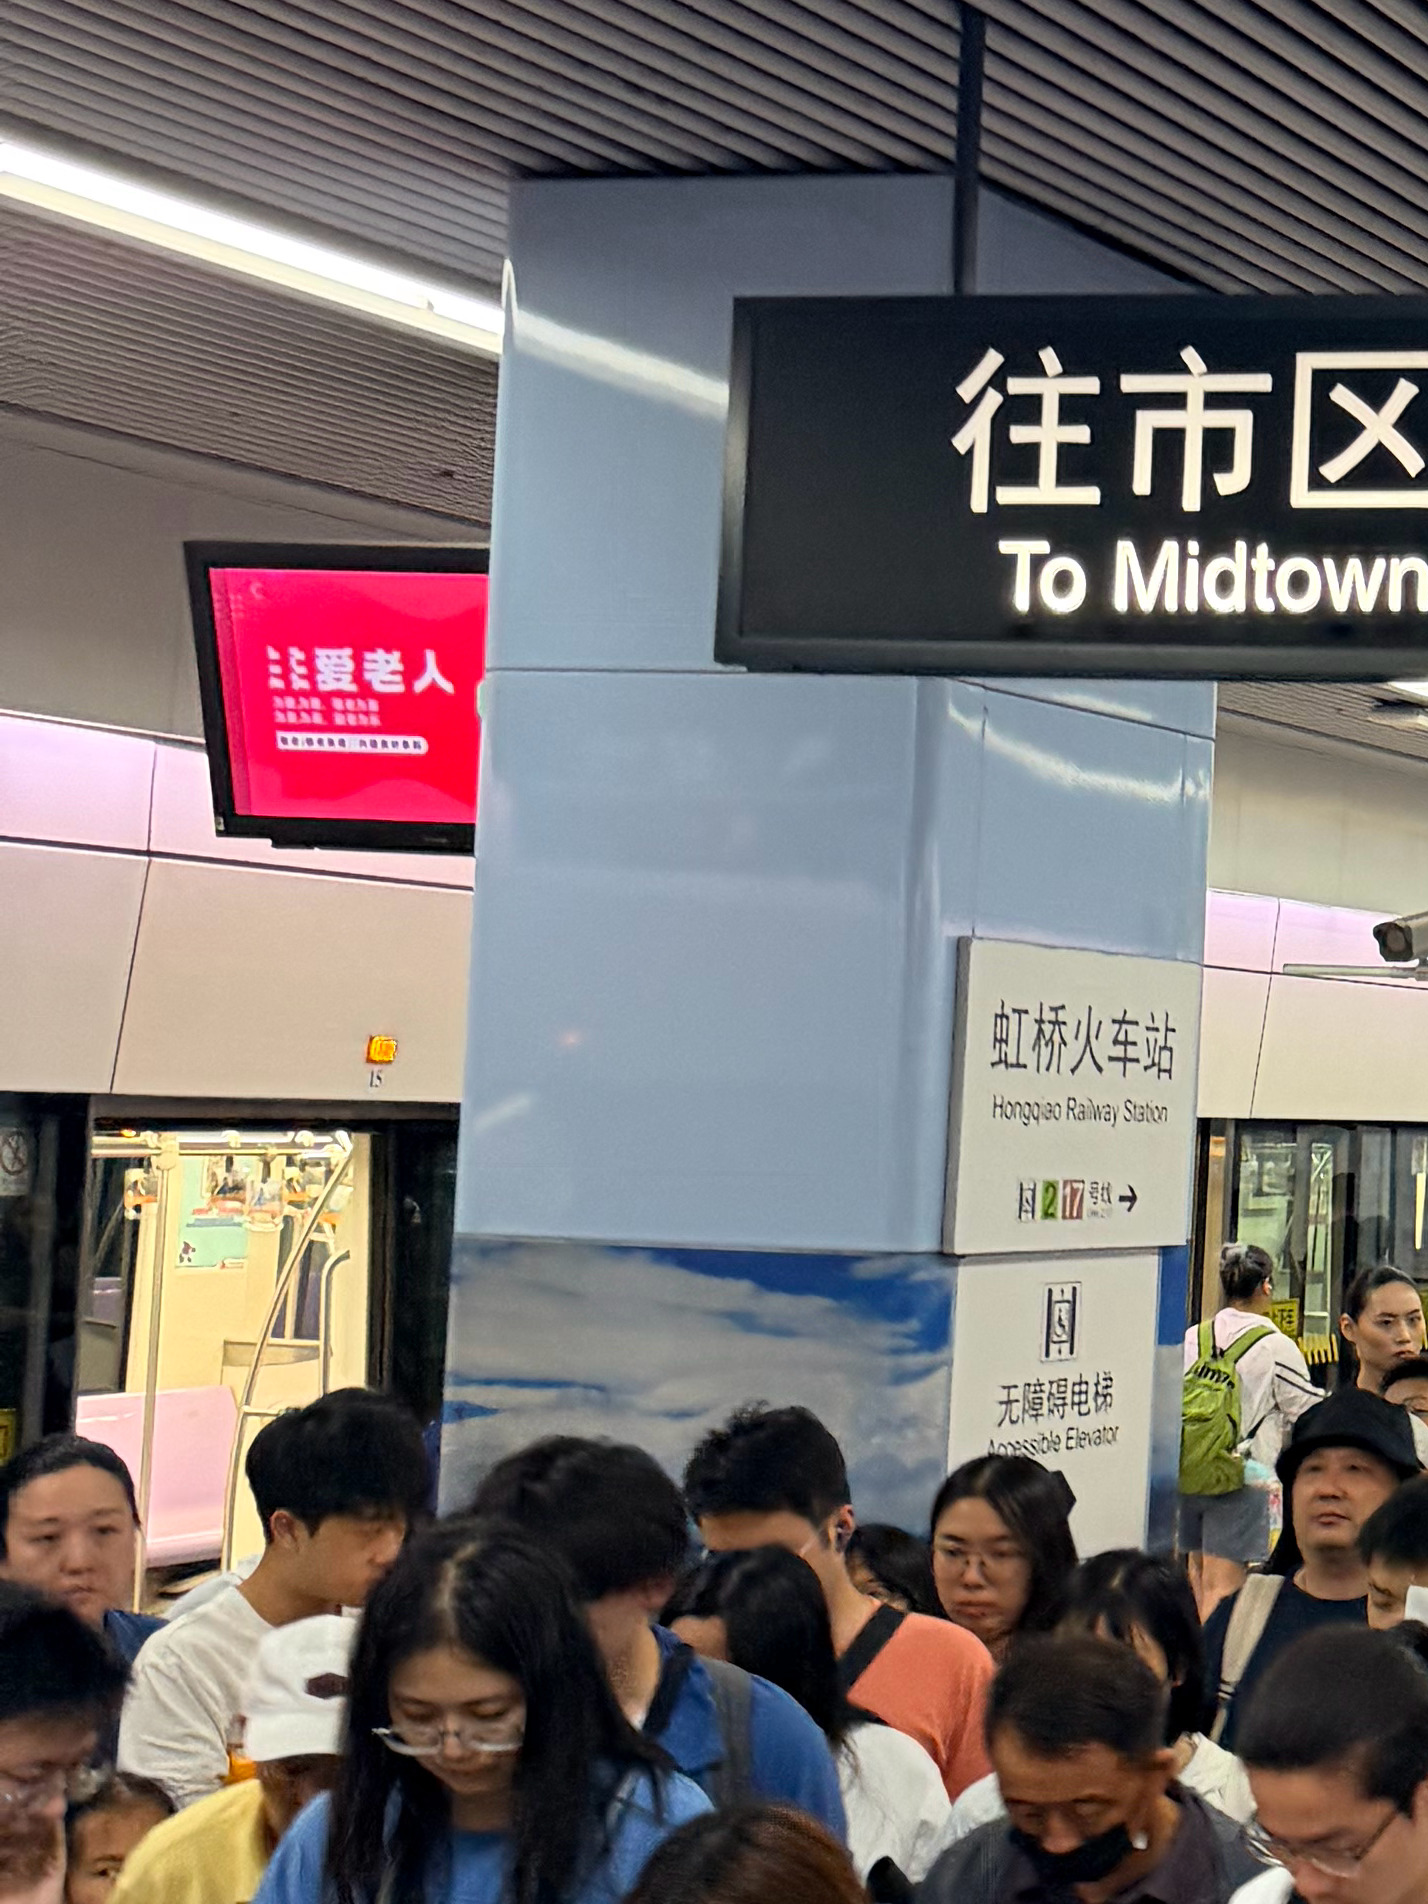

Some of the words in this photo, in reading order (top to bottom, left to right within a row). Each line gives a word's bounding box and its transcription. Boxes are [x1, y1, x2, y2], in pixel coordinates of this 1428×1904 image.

[1000, 540, 1087, 615] To
[990, 1000, 1177, 1081] 虹桥火车站
[992, 1095, 1062, 1127] Hongqiao
[1066, 1097, 1120, 1128] Railway
[1123, 1099, 1169, 1125] Station
[1044, 1181, 1057, 1218] 2
[1064, 1180, 1083, 1218] 17
[997, 1370, 1114, 1428] 无障碍电梯
[1066, 1424, 1119, 1451] Elevator
